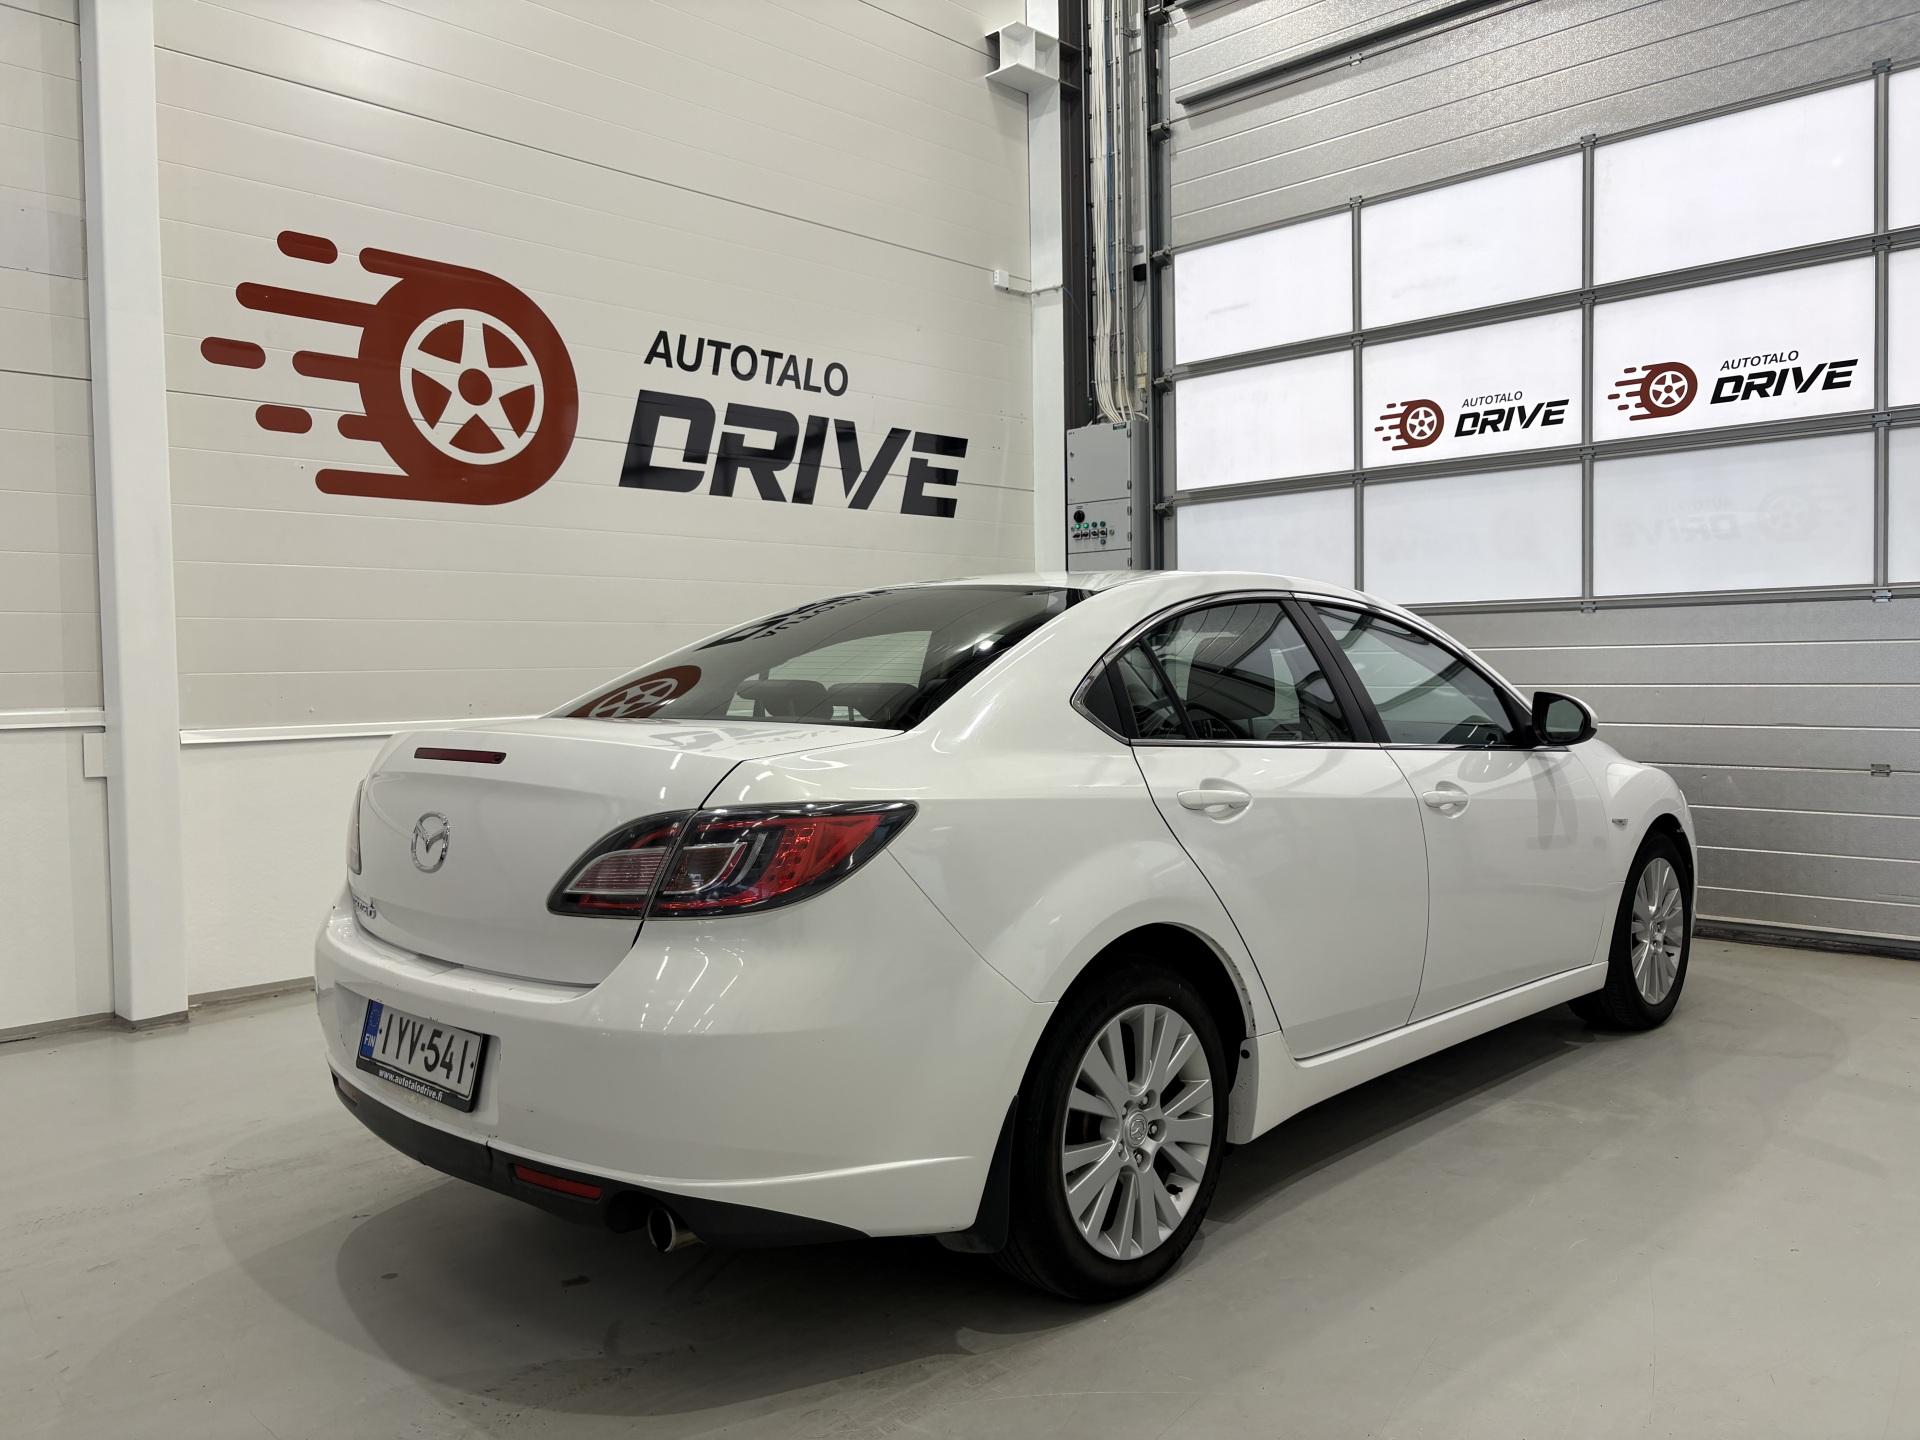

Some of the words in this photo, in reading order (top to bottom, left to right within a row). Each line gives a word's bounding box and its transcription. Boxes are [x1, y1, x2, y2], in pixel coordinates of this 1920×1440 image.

[644, 330, 849, 397] AUTOTALO
[1720, 350, 1799, 371] AUTOTALO
[1461, 390, 1523, 408] AUTOTALO
[1710, 358, 1859, 405] DRIVE
[1454, 398, 1570, 438] DRIVE
[618, 389, 969, 519] DRIVE
[364, 1033, 376, 1048] FIN
[381, 1013, 469, 1084] IYV-541
[378, 1068, 443, 1101] www.autotalodrive.fi
